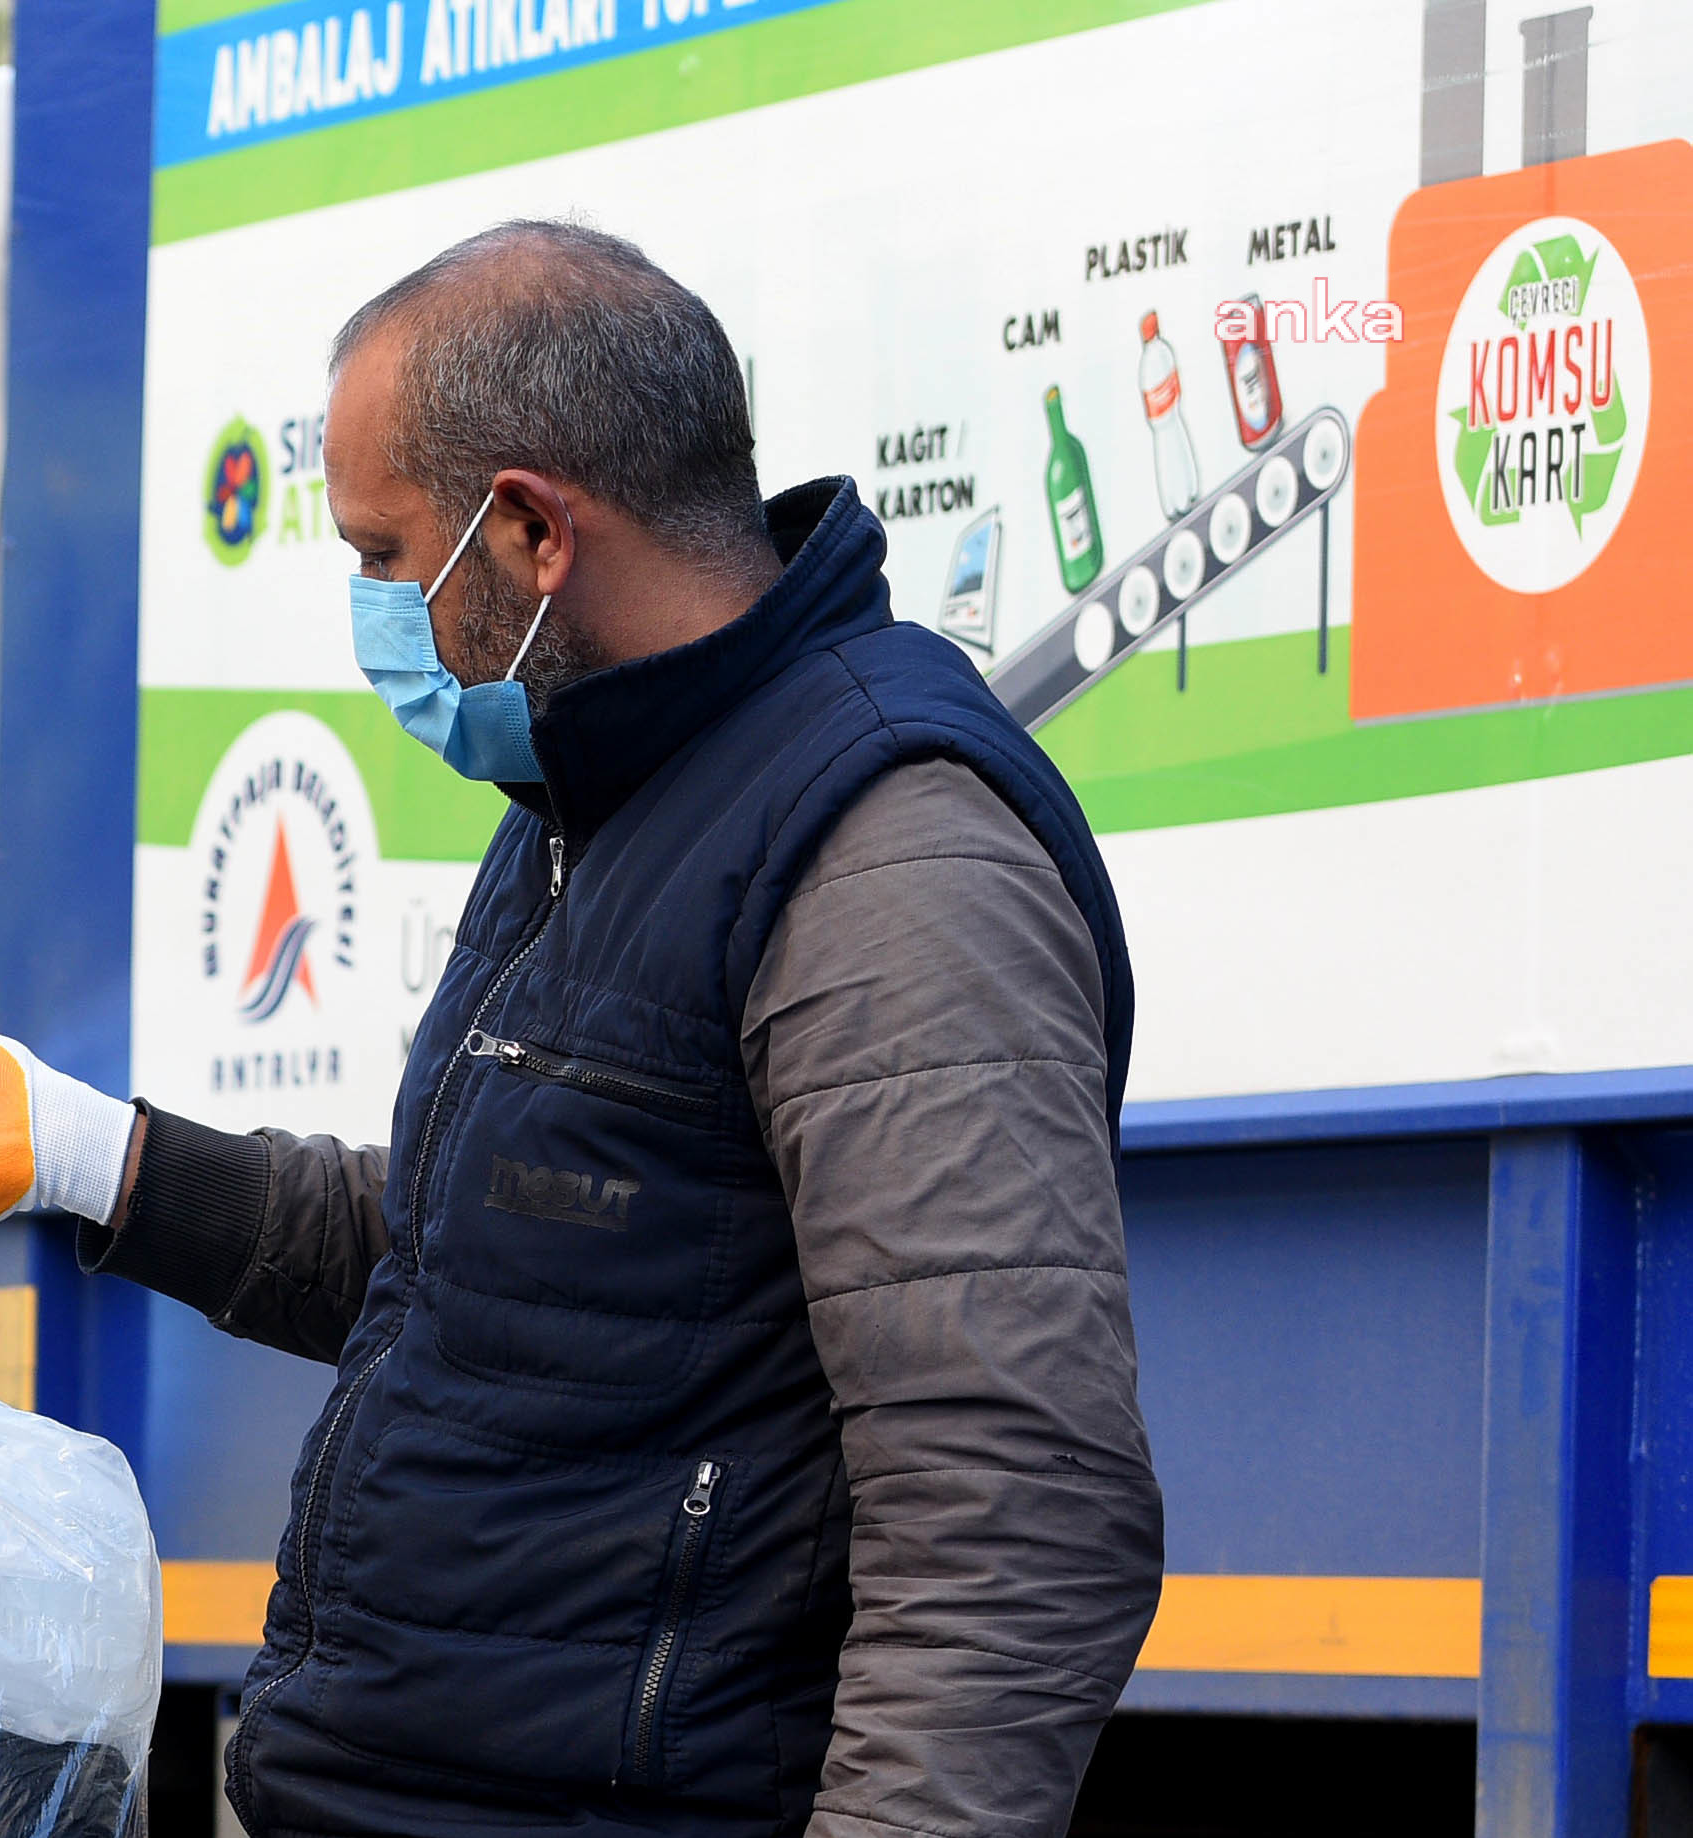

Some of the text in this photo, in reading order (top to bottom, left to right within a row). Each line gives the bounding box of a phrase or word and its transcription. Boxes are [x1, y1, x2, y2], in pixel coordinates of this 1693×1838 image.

[207, 2, 404, 137] AMBALAJ
[1086, 225, 1189, 281] PLASTİK
[1248, 216, 1336, 265] METAL
[1003, 309, 1061, 352] CAM
[1469, 318, 1612, 427] KOMŞU
[876, 422, 949, 469] KAĞIT
[1492, 422, 1586, 510] KART
[876, 475, 976, 523] KARTON
